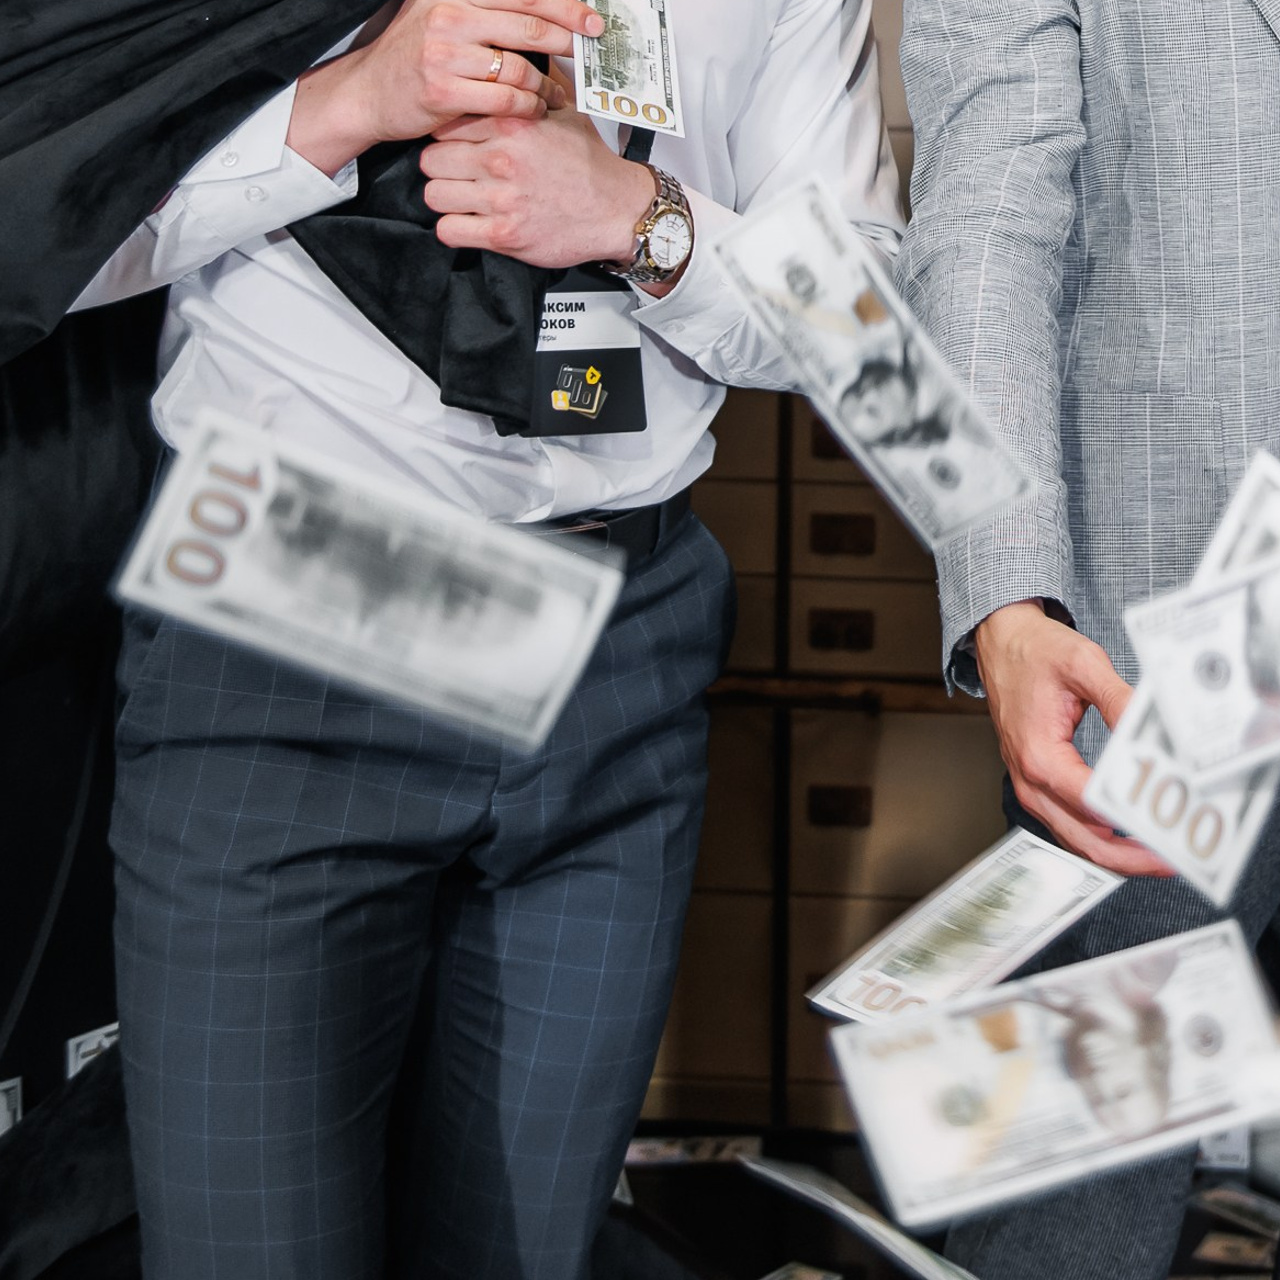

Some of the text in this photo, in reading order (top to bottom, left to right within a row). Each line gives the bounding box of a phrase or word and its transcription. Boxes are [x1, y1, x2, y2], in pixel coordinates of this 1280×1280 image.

[592, 90, 667, 125] 100
[166, 456, 263, 587] 100
[1127, 757, 1224, 860] 100
